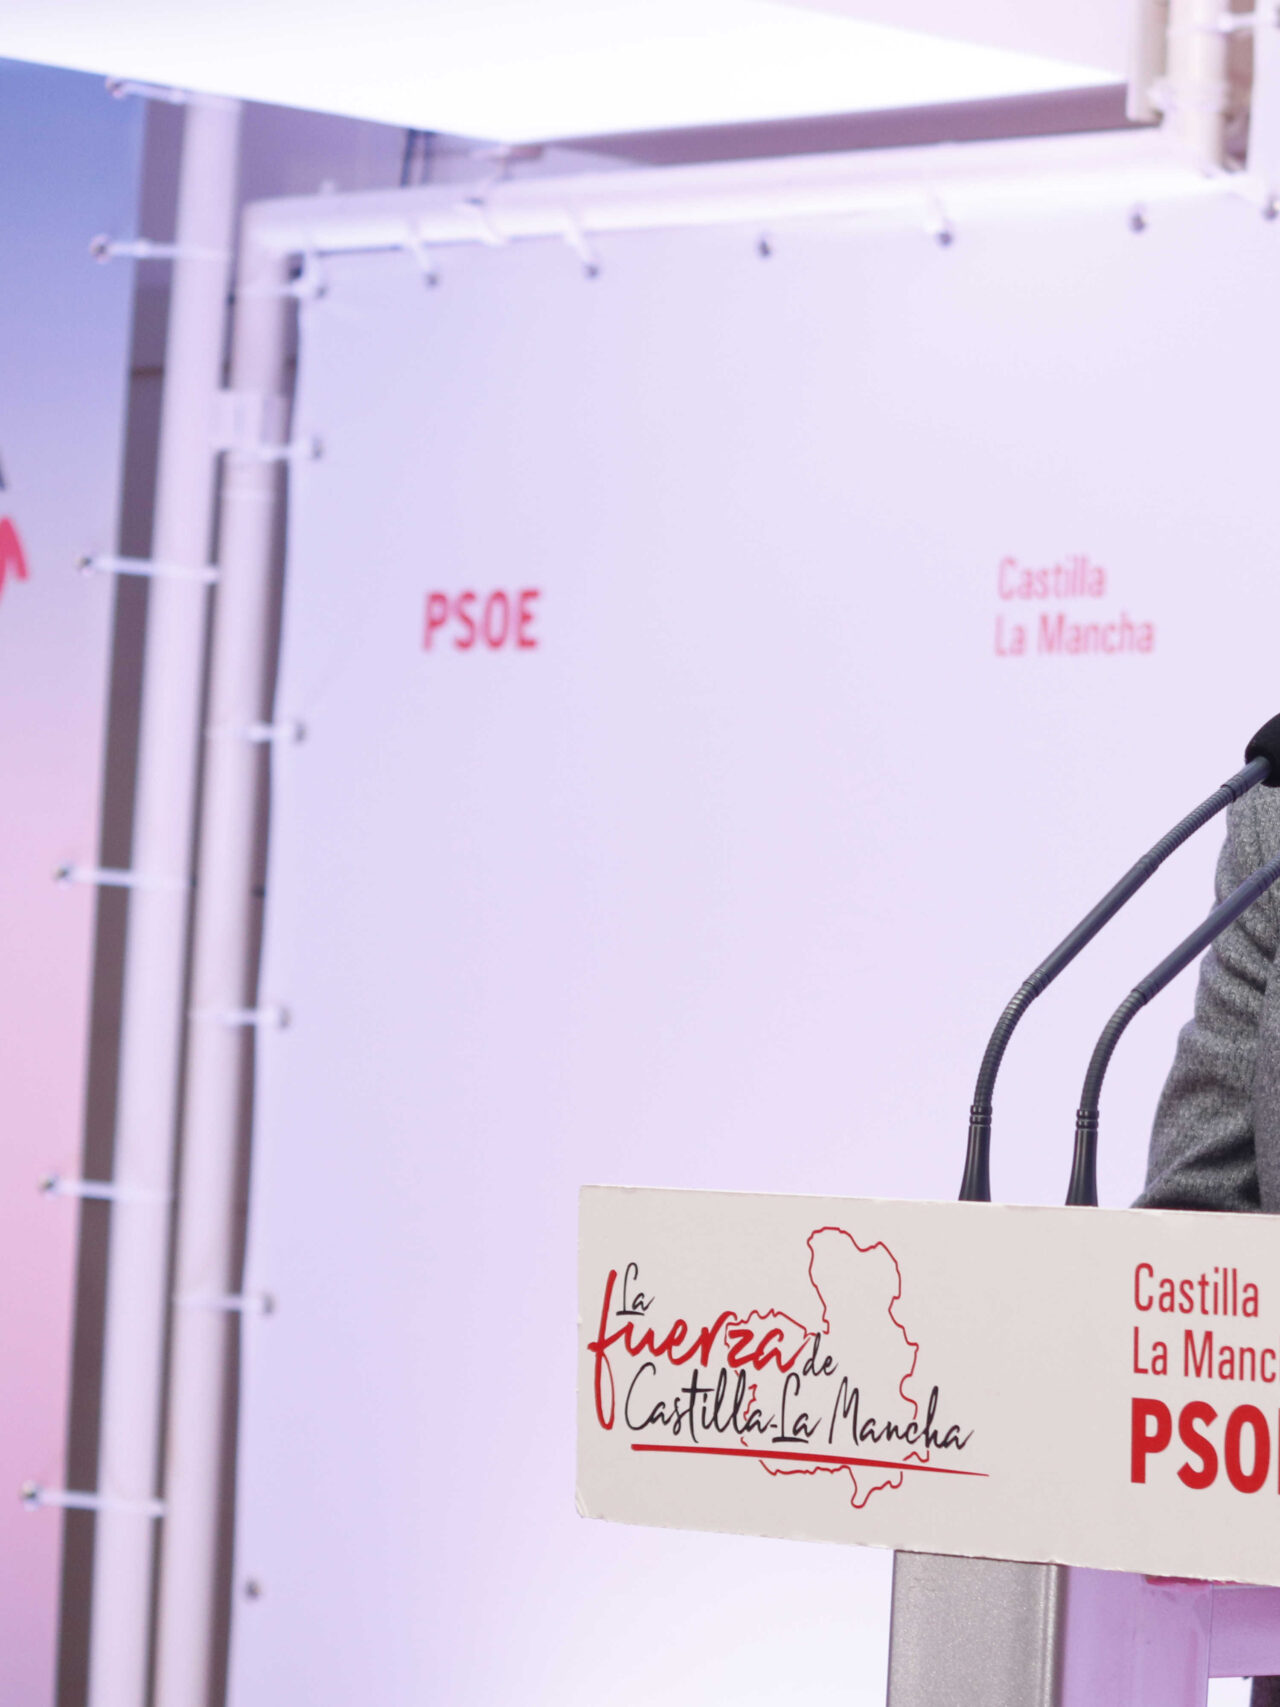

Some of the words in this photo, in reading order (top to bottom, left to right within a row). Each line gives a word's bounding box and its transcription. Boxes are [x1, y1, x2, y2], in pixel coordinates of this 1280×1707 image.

[998, 555, 1105, 600] Castilla
[423, 590, 541, 651] PSOE
[995, 614, 1025, 656] La
[1037, 611, 1154, 654] Mancha
[616, 1262, 655, 1316] La
[1134, 1262, 1259, 1318] Castilla
[587, 1269, 811, 1430] fuerza
[803, 1332, 838, 1376] de
[1133, 1326, 1168, 1376] La
[828, 1376, 975, 1450] Mancha
